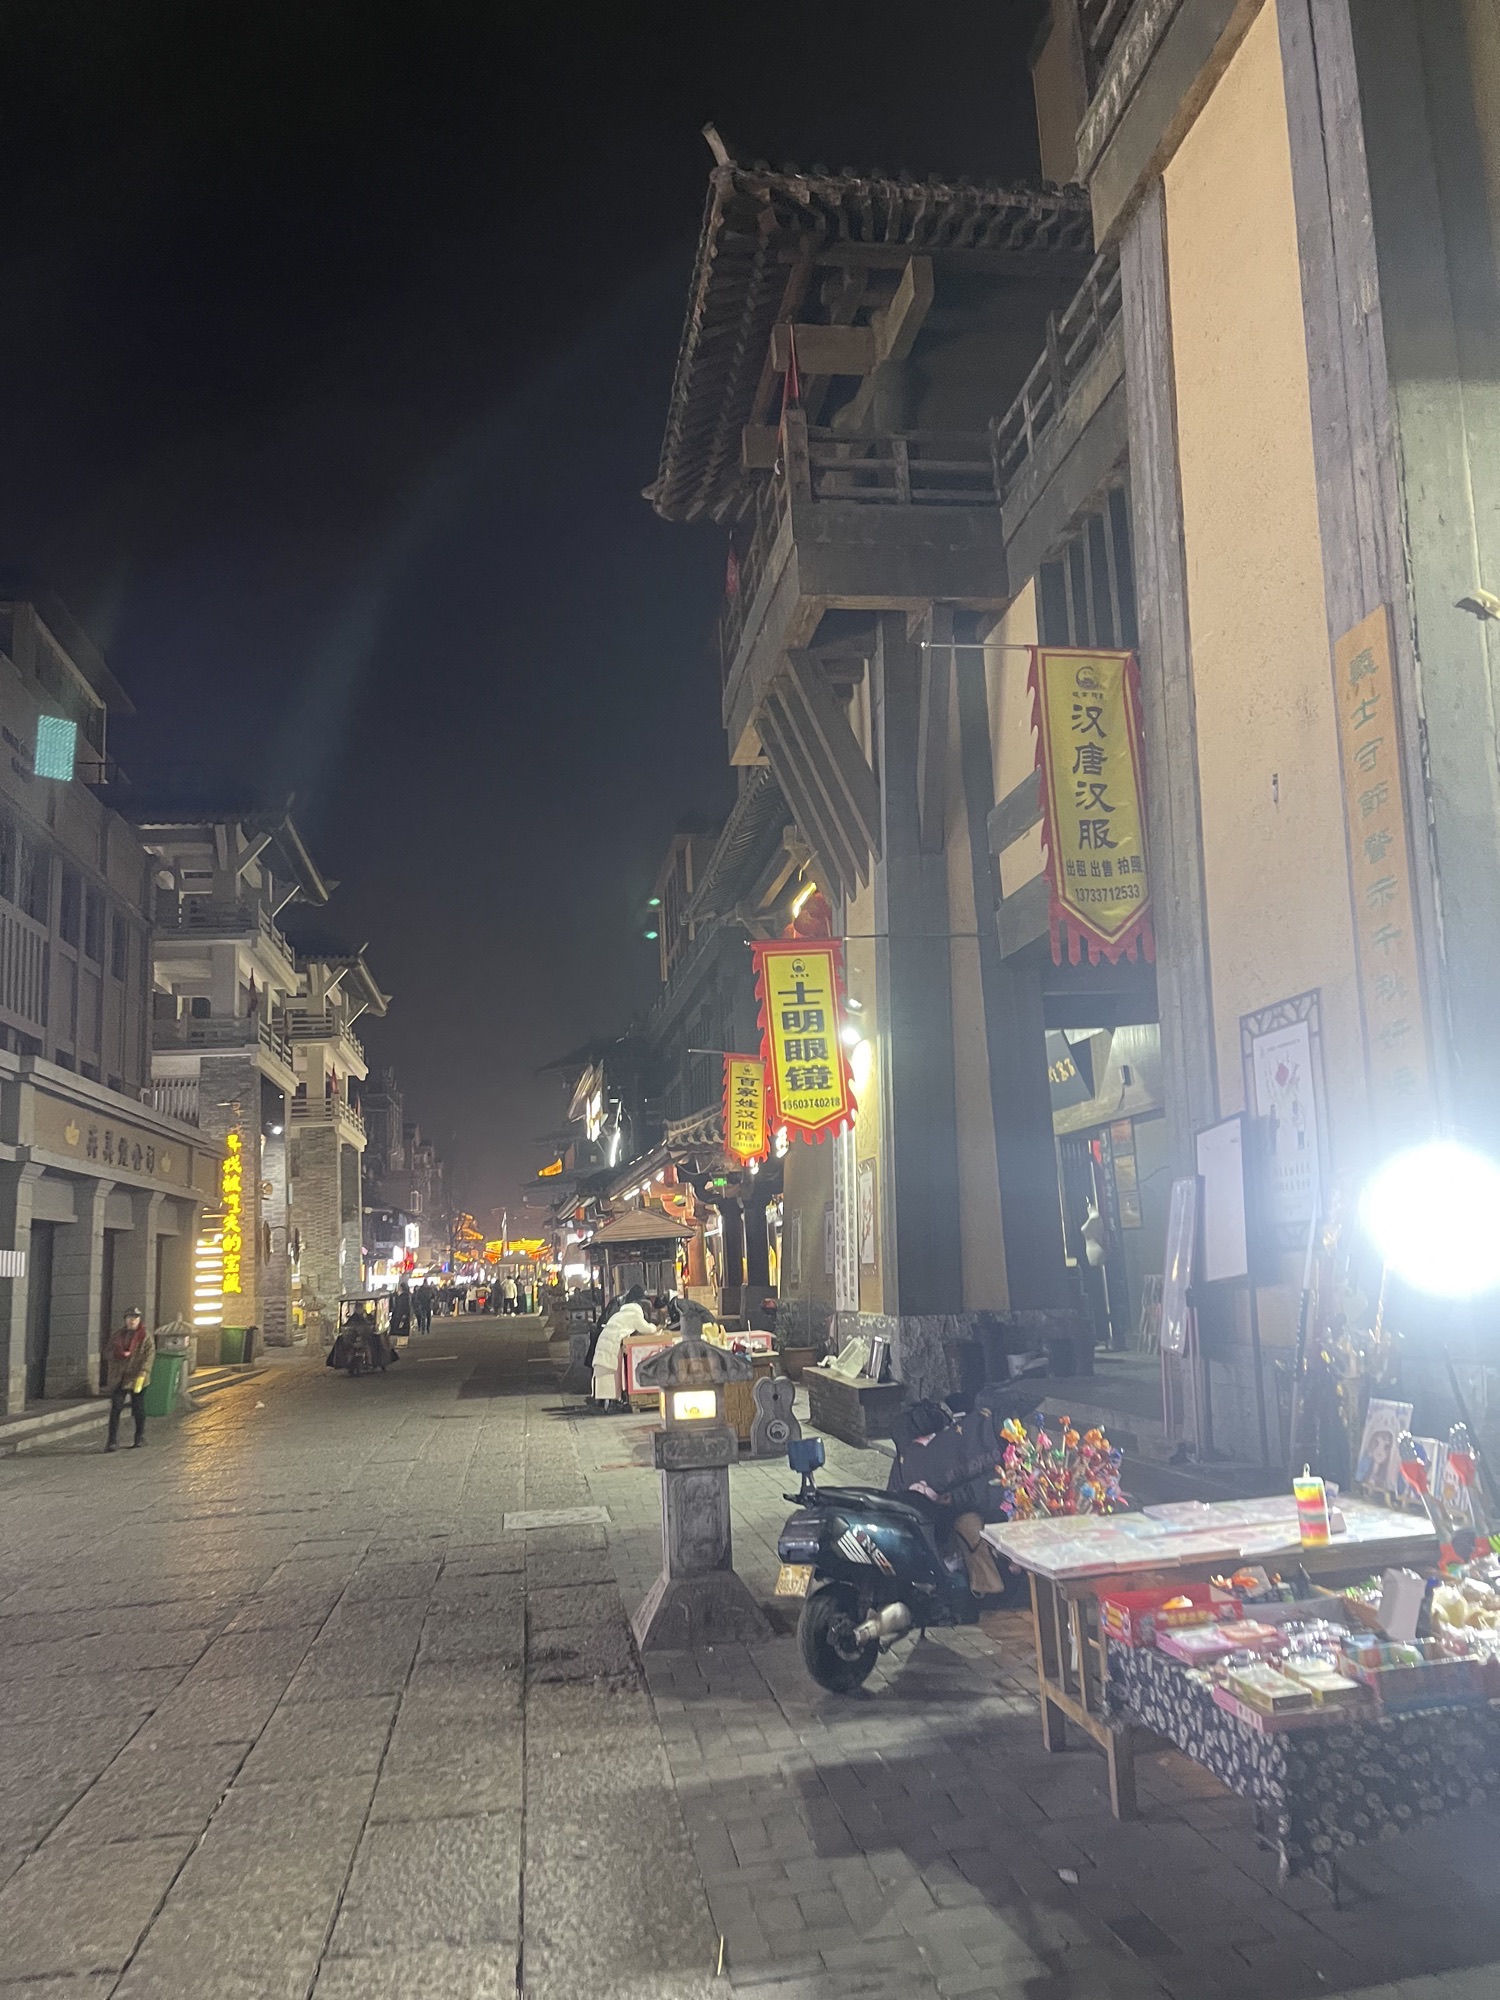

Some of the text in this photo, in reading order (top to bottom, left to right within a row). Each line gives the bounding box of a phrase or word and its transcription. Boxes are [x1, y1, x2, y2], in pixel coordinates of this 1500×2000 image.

[1071, 703, 1119, 850] 汉唐汉服
[1066, 856, 1144, 878] 出租 出售 拍照
[1075, 884, 1140, 902] 13733712533
[778, 981, 833, 1092] 士明眼镜
[735, 1076, 760, 1142] 百家姓汉服馆
